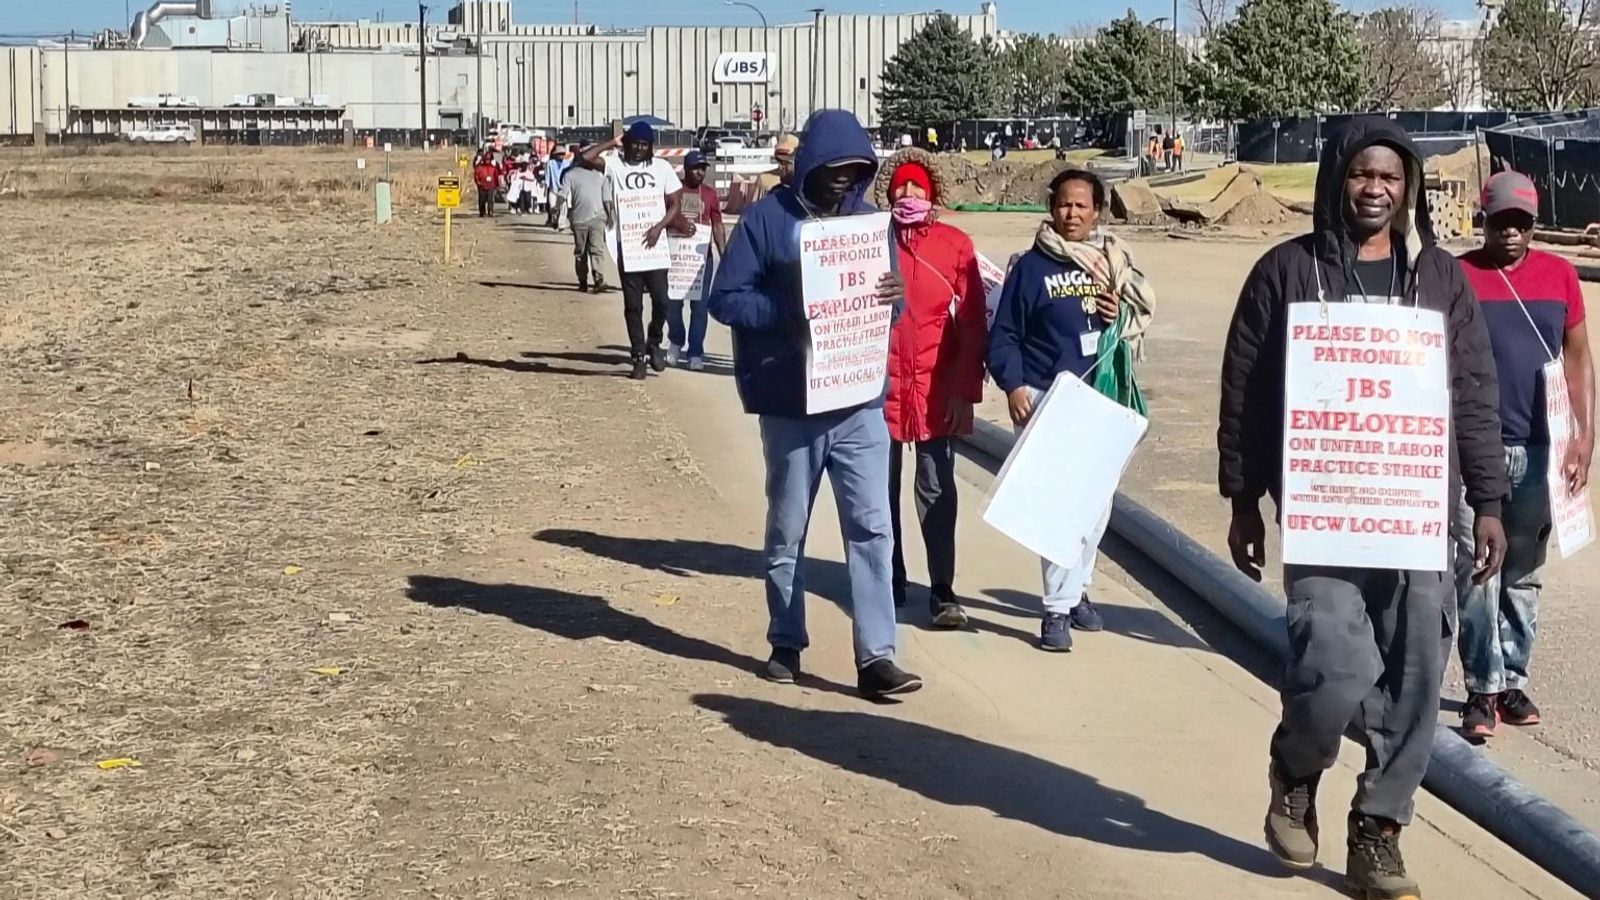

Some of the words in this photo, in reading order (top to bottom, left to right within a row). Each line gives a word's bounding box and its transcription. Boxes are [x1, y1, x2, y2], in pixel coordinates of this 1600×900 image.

[803, 234, 848, 252] PLEASE
[851, 233, 870, 245] DO
[872, 229, 887, 243] NOT
[819, 246, 883, 267] PATRONIZE
[839, 271, 866, 291] JBS
[1044, 270, 1093, 299] NUGG
[808, 293, 877, 319] EMPLOYE
[814, 324, 831, 336] ON
[1292, 325, 1366, 342] PLEASE
[1370, 327, 1400, 343] DO
[1406, 329, 1444, 348] NOT
[1314, 346, 1426, 366] PATRONIZE
[810, 375, 841, 390] UFCW
[843, 367, 874, 384] LOCAL
[1345, 378, 1392, 403] JBS
[1290, 410, 1446, 437] EMPLOYEES
[1288, 437, 1316, 451] ON
[1320, 438, 1385, 454] UNFAIR
[1387, 441, 1444, 458] LABOR
[1289, 458, 1379, 475] PRACTICE
[1382, 463, 1443, 479] STRIKE
[1287, 514, 1346, 532] UFCW
[1349, 517, 1417, 536] LOCAL
[1421, 521, 1443, 537] #7
